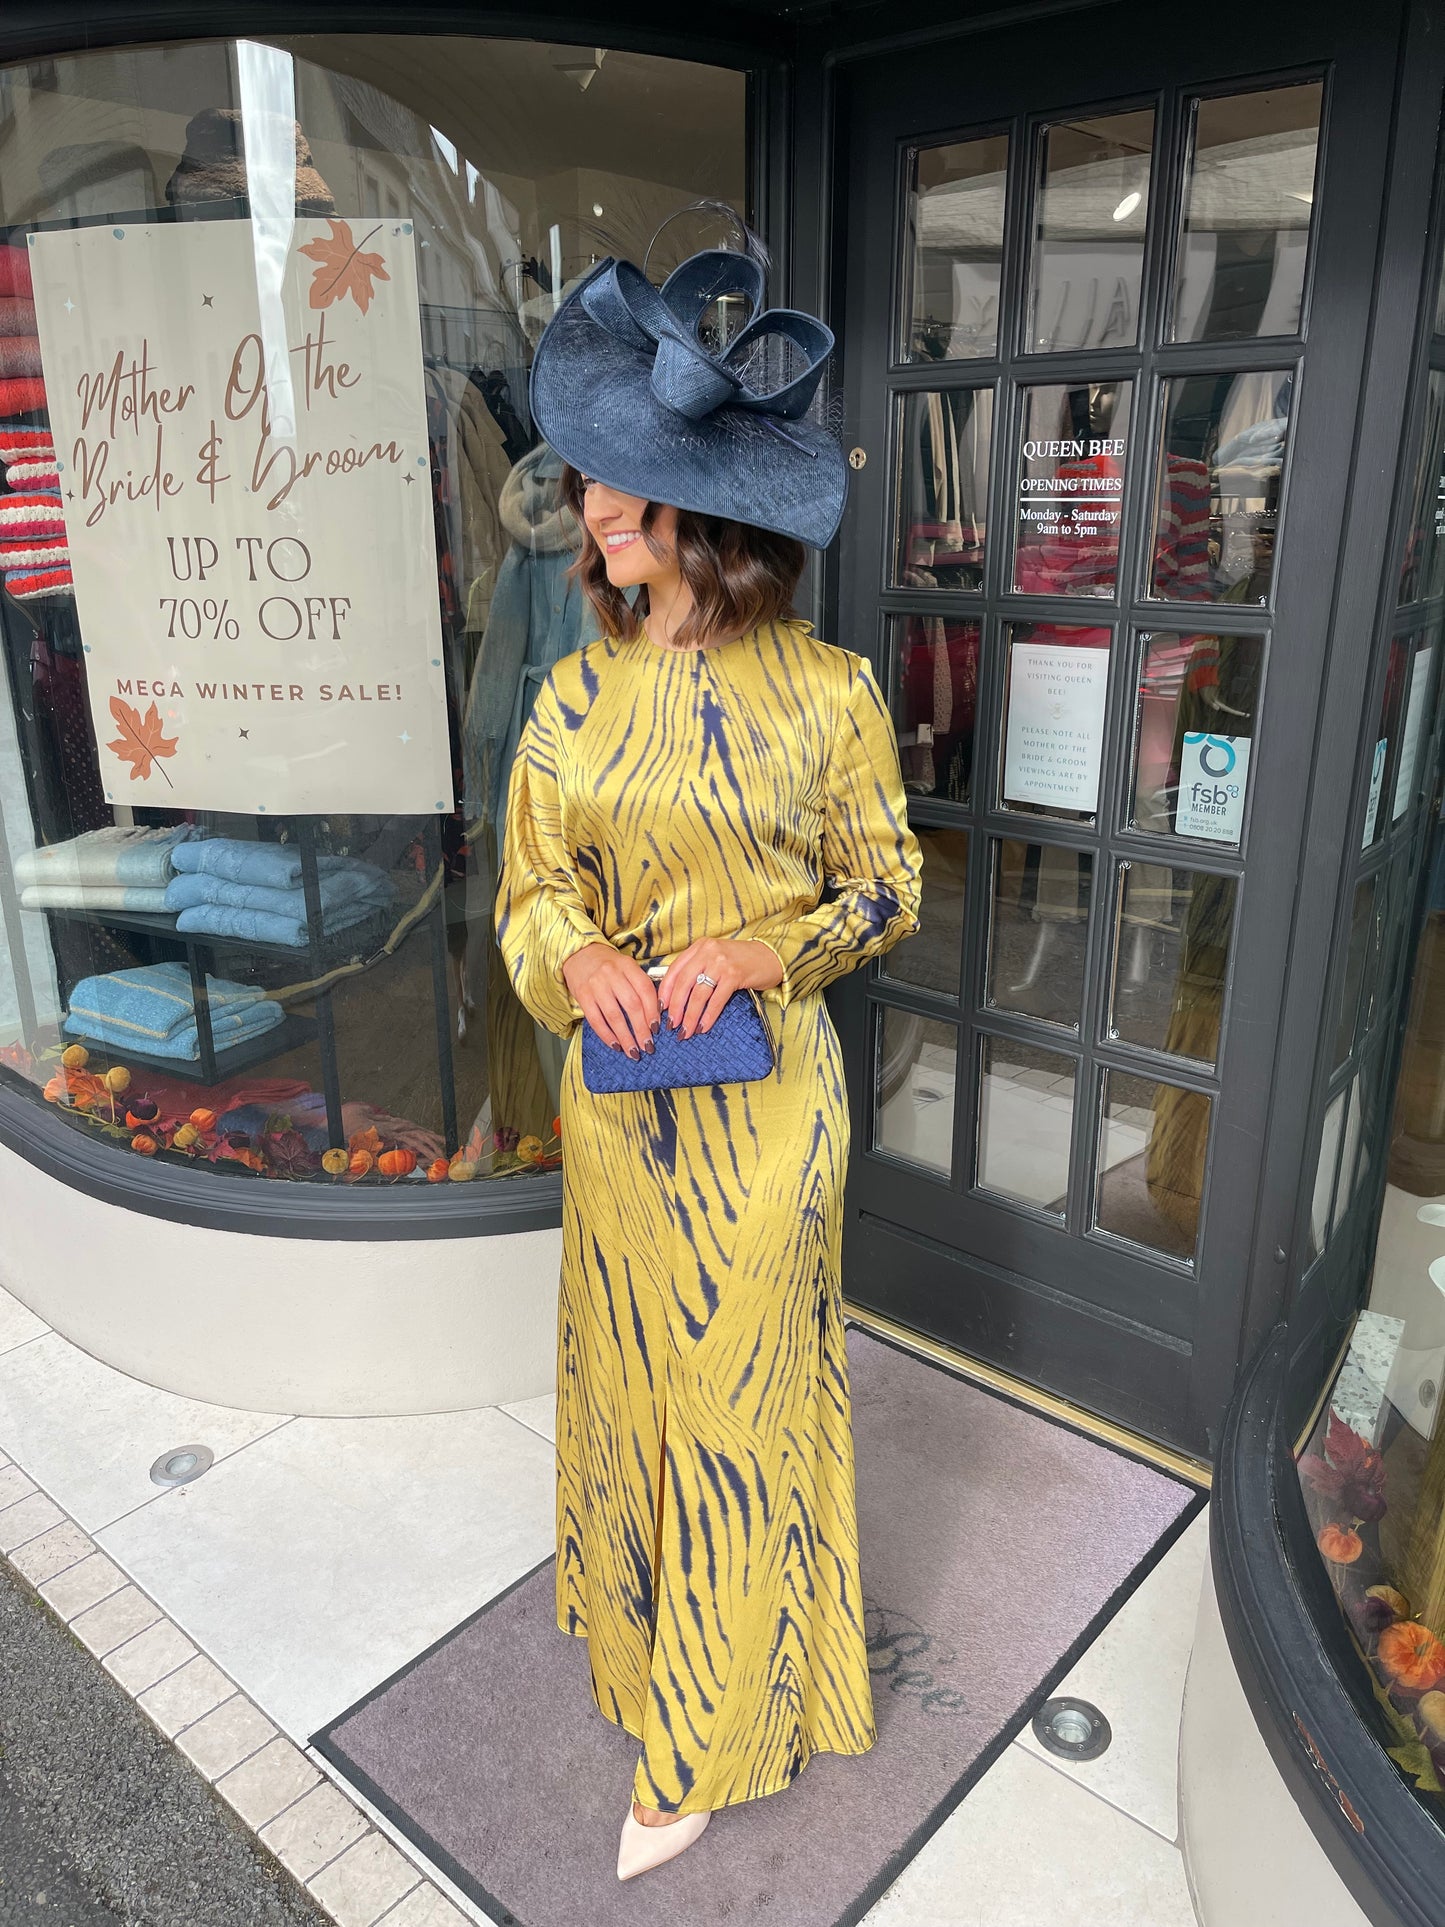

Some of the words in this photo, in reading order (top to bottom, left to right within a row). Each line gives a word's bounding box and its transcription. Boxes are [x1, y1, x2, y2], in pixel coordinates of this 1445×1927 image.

[77, 338, 196, 440] Mother
[289, 311, 363, 412] the
[1023, 440, 1085, 461] QUEEN
[1088, 439, 1125, 457] BEE
[72, 424, 184, 528] Bride
[196, 420, 231, 504] &
[252, 417, 404, 511] Groom
[1020, 478, 1078, 491] OPENING
[1080, 478, 1122, 491] TIMES
[1020, 508, 1062, 523] Monday
[1071, 508, 1118, 524] Saturday
[1037, 522, 1058, 535] 9am
[1061, 524, 1071, 535] to
[1074, 524, 1097, 538] 5pm
[167, 537, 219, 582] UP
[236, 537, 312, 582] TO
[160, 598, 240, 641] 70%
[258, 596, 352, 641] OFF
[1028, 659, 1054, 667] THANK
[1058, 660, 1073, 668] YOU
[1077, 662, 1093, 670] FOR
[1027, 673, 1062, 682] VISITING
[1064, 675, 1092, 684] QUEEN
[117, 678, 185, 699] MEGA
[196, 682, 304, 702] WINTER
[319, 684, 402, 702] SALE!
[1021, 726, 1049, 736] PLEASE
[1053, 730, 1073, 738] NOTE
[1077, 732, 1090, 740] ALL
[1023, 740, 1055, 750] MOTHER
[1072, 745, 1087, 753] THE
[1021, 753, 1044, 762] BRIDE
[1057, 757, 1087, 767] GROOM
[1018, 766, 1056, 777] VIEWINGS
[1058, 770, 1073, 779] ARE
[1024, 781, 1079, 793] APPOINTMENT
[1191, 782, 1228, 805] fsb
[1191, 803, 1227, 816] MEMBER
